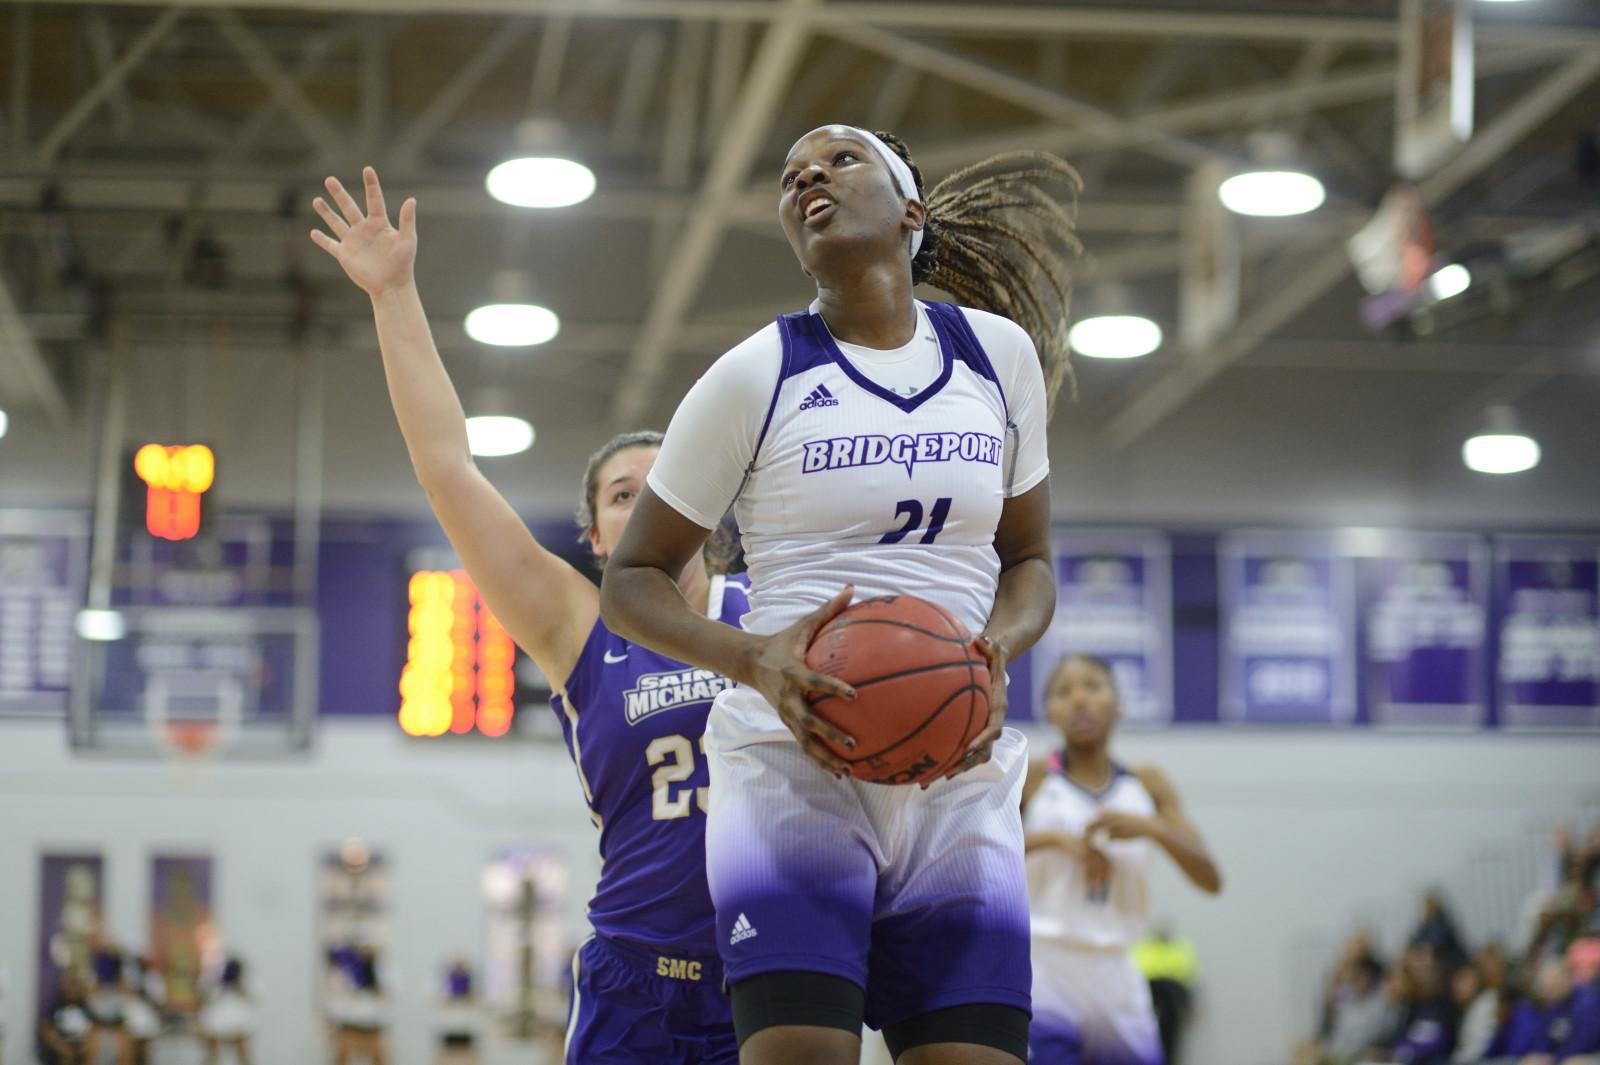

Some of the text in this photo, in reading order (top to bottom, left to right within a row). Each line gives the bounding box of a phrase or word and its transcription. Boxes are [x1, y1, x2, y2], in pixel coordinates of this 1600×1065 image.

[799, 398, 839, 411] adidas
[802, 432, 1002, 481] BRIDGEPORT
[877, 497, 953, 545] 21
[639, 669, 719, 690] SAIN
[730, 928, 758, 945] adidas
[656, 956, 702, 981] SMC
